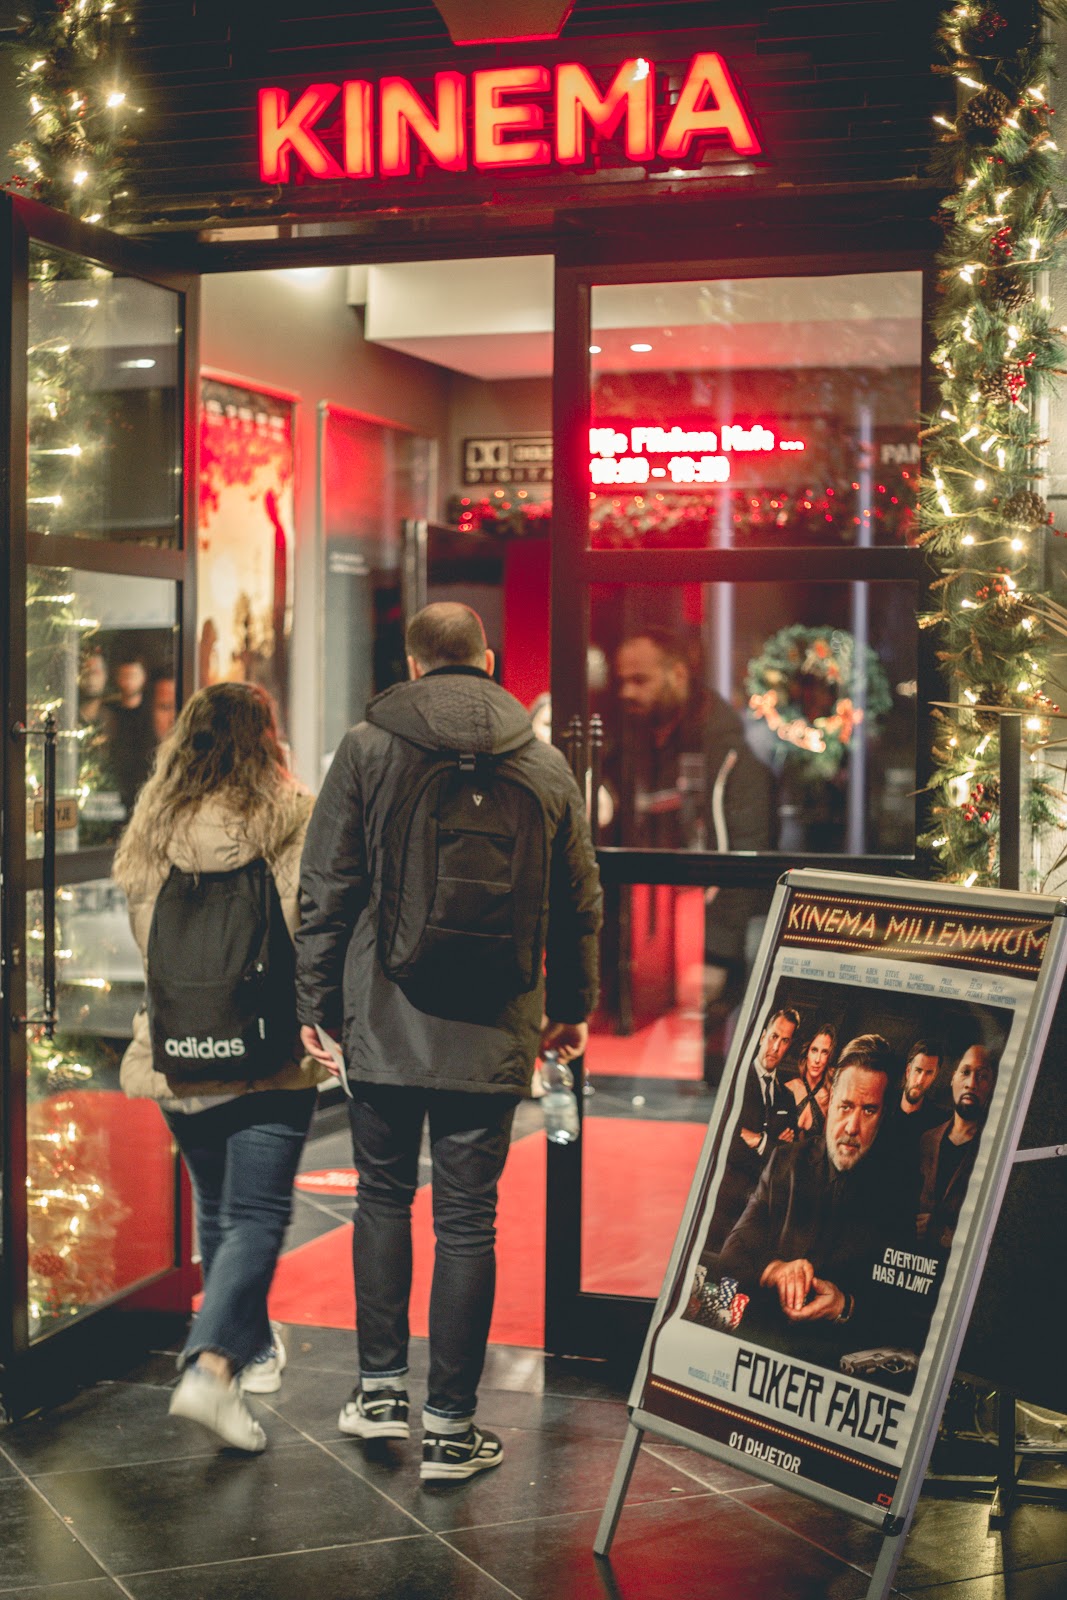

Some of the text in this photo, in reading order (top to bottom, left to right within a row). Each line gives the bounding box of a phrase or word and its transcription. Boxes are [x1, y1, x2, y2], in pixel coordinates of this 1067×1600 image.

[257, 51, 762, 184] KINEMA
[787, 902, 1049, 960] KINEMA MILLENNIUM
[165, 1036, 245, 1059] adidas
[872, 1264, 933, 1295] HAS A LIMIT
[883, 1247, 938, 1276] EVERYONE
[731, 1347, 906, 1450] POKER FACE
[728, 1431, 802, 1473] 01 DHJETOR
